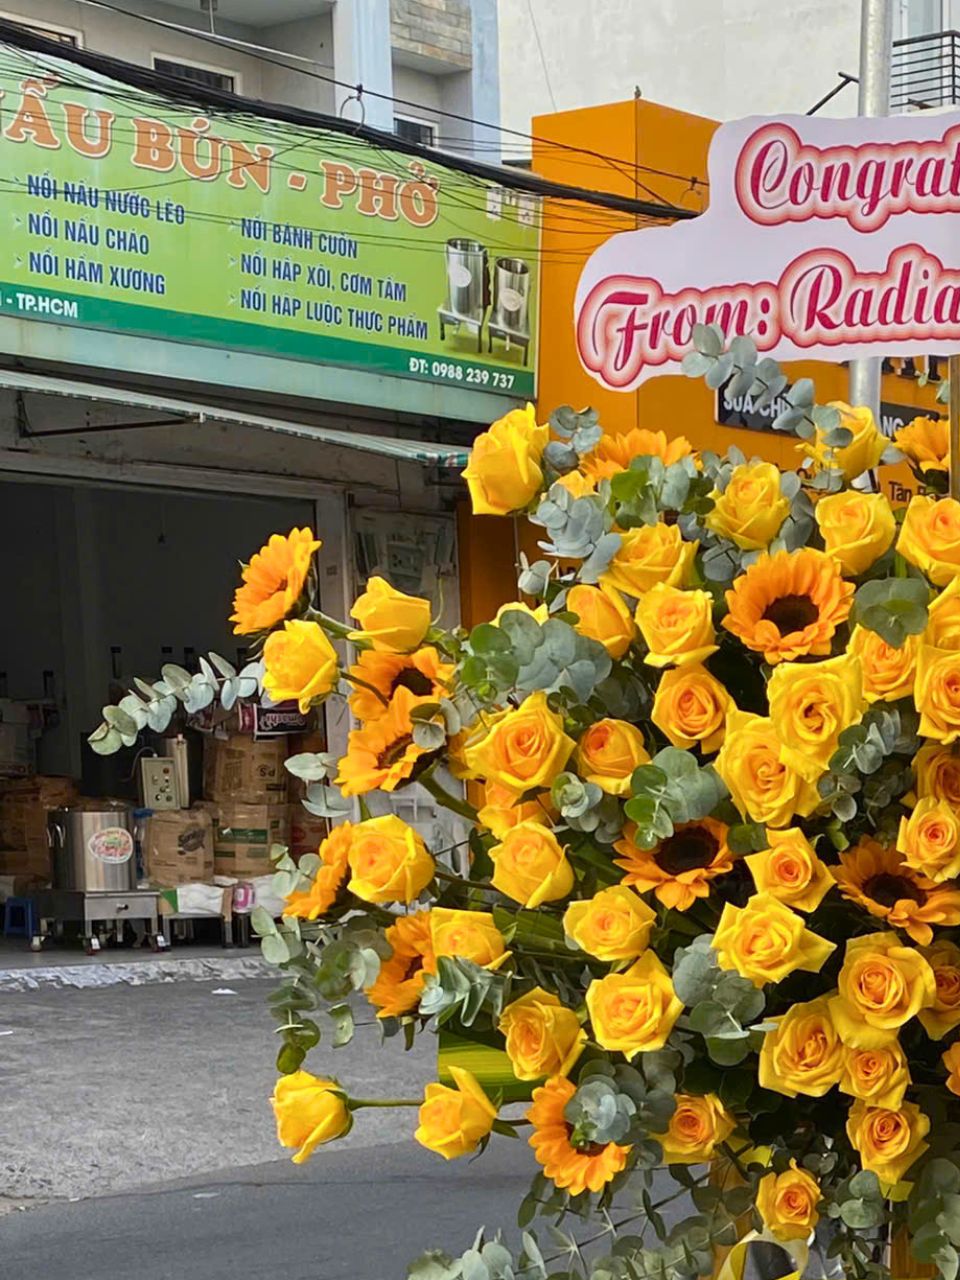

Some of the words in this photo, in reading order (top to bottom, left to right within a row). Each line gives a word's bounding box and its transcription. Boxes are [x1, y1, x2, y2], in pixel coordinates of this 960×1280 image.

[0, 73, 114, 158] ẤU
[130, 117, 273, 193] BÚN
[320, 160, 441, 228] PHỞ
[110, 265, 165, 295] XƯƠNG
[341, 272, 372, 296] CƠM
[16, 292, 78, 319] TP.HCM
[590, 289, 772, 372] From:
[409, 357, 428, 374] ĐT:
[432, 361, 463, 380] 0988
[466, 367, 489, 385] 239
[492, 373, 515, 389] 737
